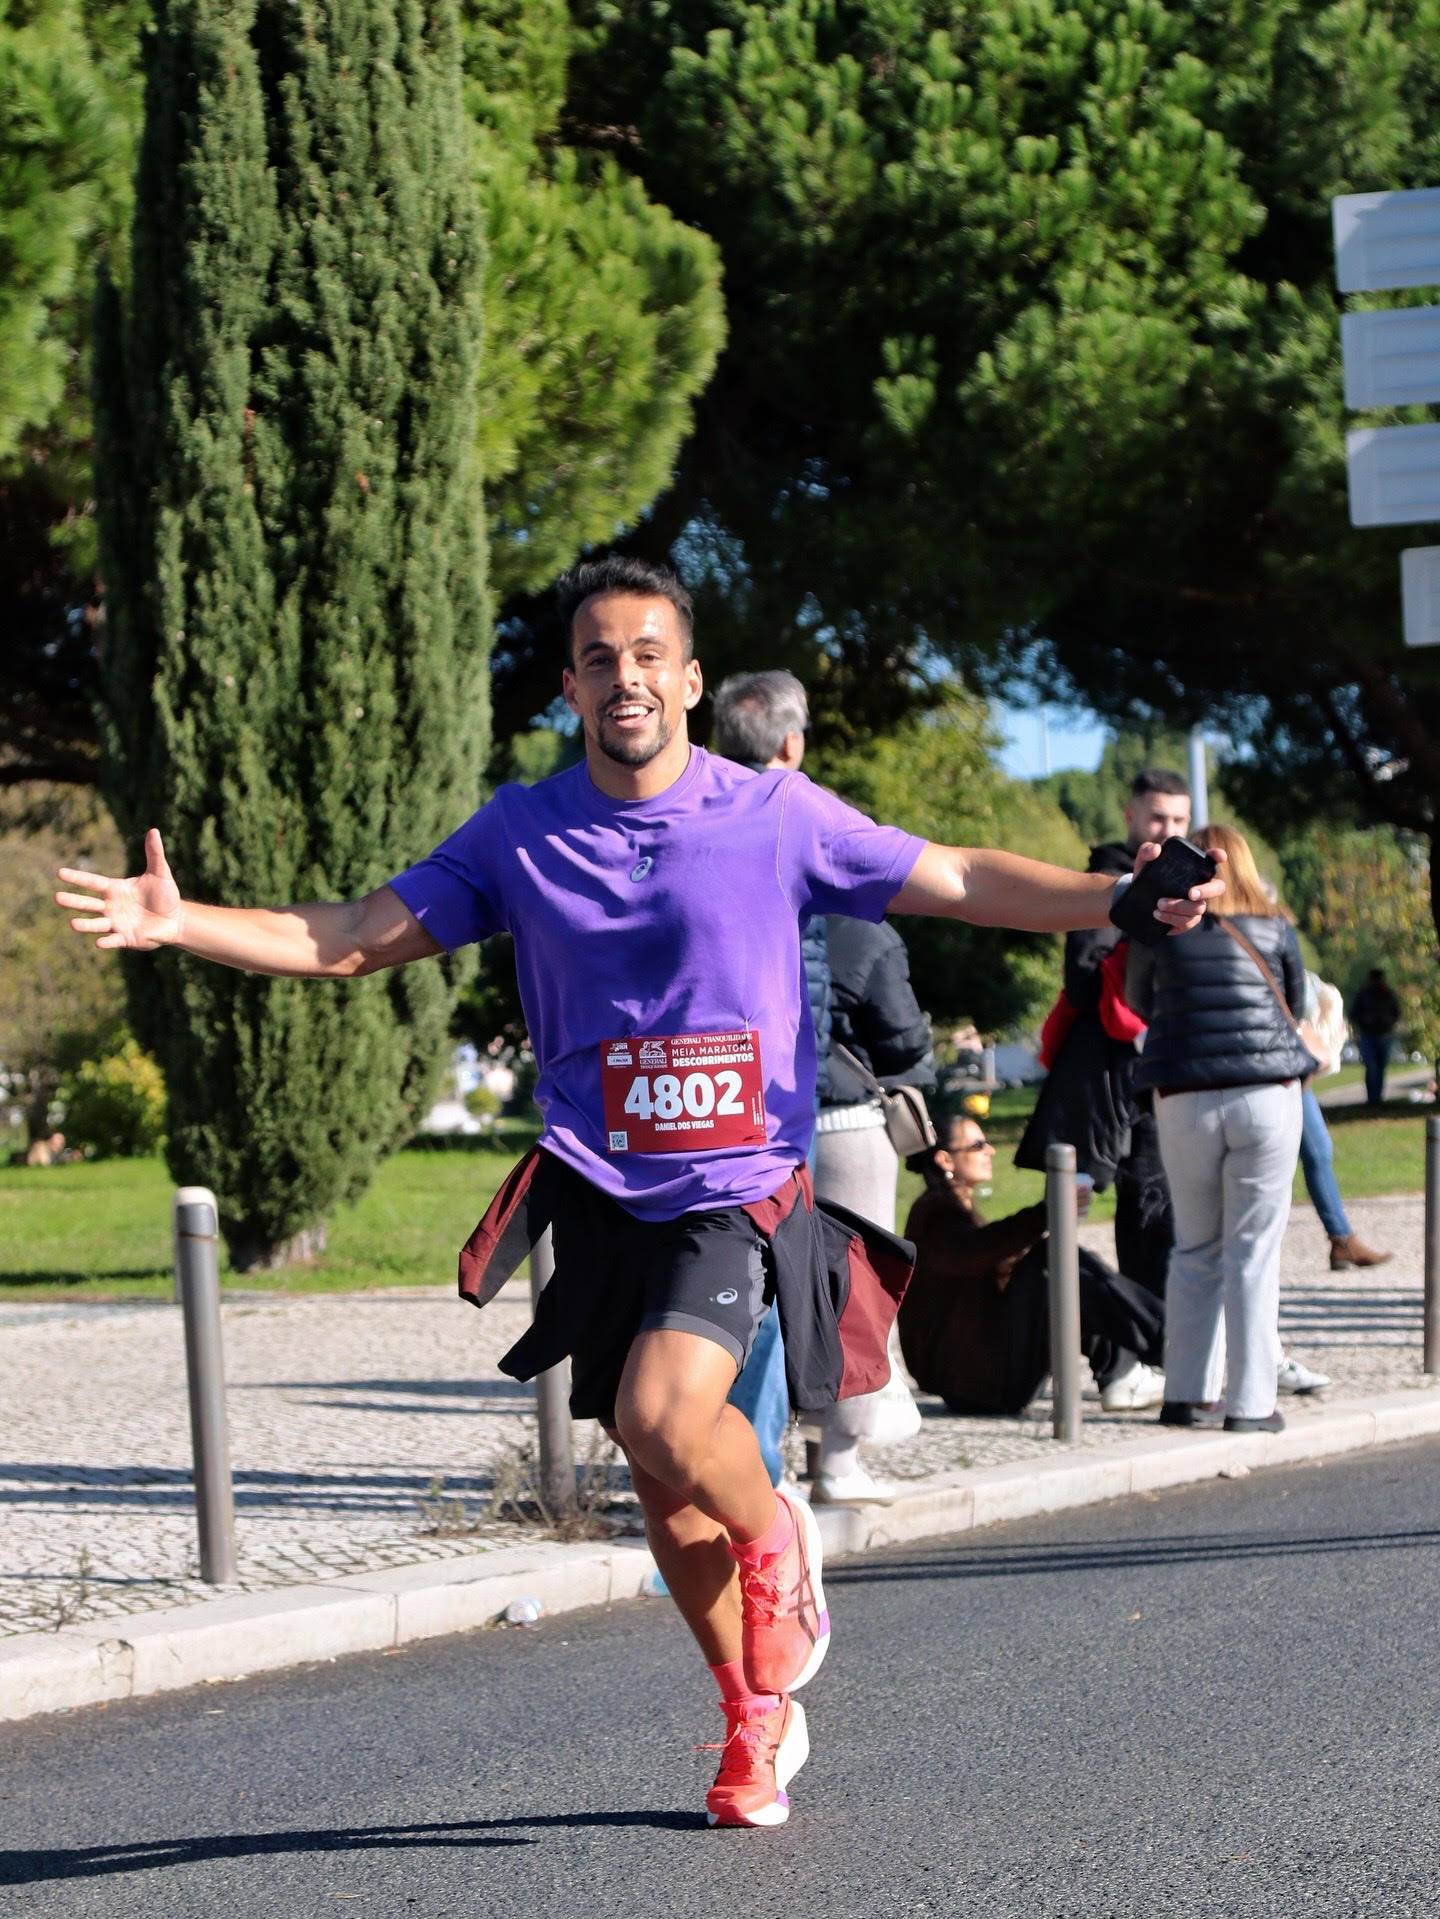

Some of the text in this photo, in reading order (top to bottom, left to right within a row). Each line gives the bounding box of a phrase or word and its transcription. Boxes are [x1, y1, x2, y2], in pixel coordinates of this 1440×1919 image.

[671, 1037, 701, 1045] GENERALI
[672, 1043, 753, 1056] MEIA MARATONA
[672, 1052, 754, 1067] DESCOBRIMENTOS
[624, 1070, 744, 1120] 4802
[655, 1120, 714, 1131] DANIEL DOS VIEGAS
